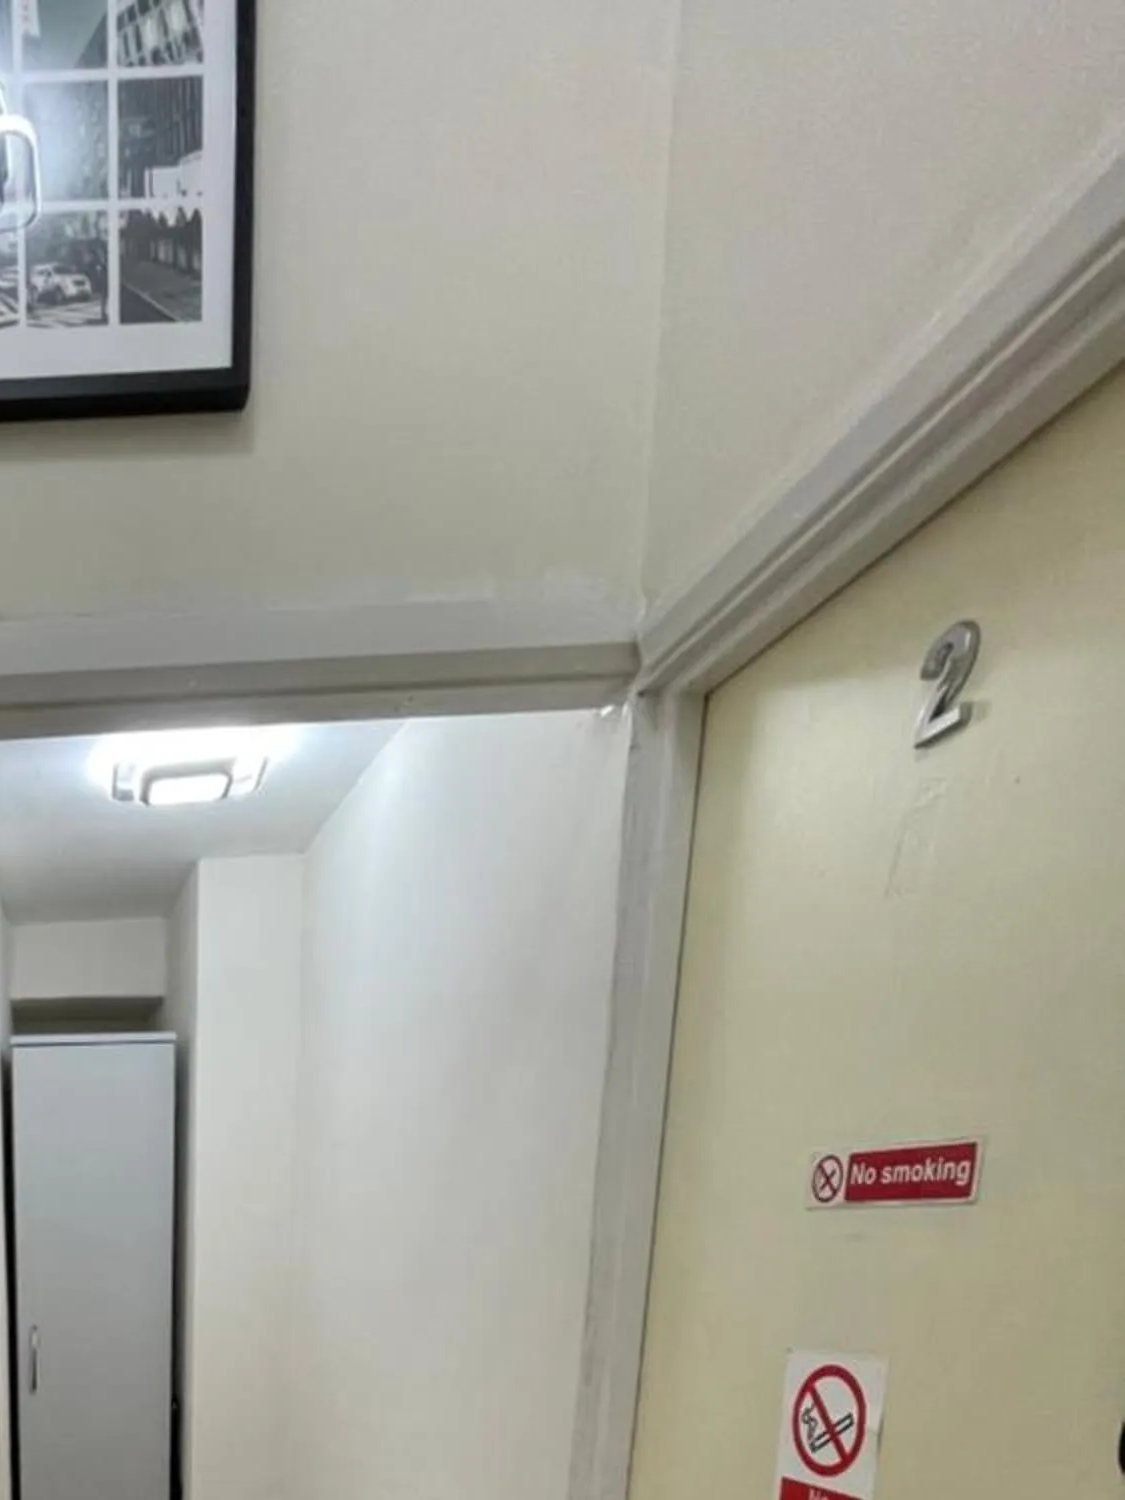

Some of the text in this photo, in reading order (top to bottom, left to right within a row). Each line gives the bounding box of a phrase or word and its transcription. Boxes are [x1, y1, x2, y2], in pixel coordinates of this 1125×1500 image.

[913, 620, 981, 750] 2
[850, 1157, 971, 1186] No smoking
